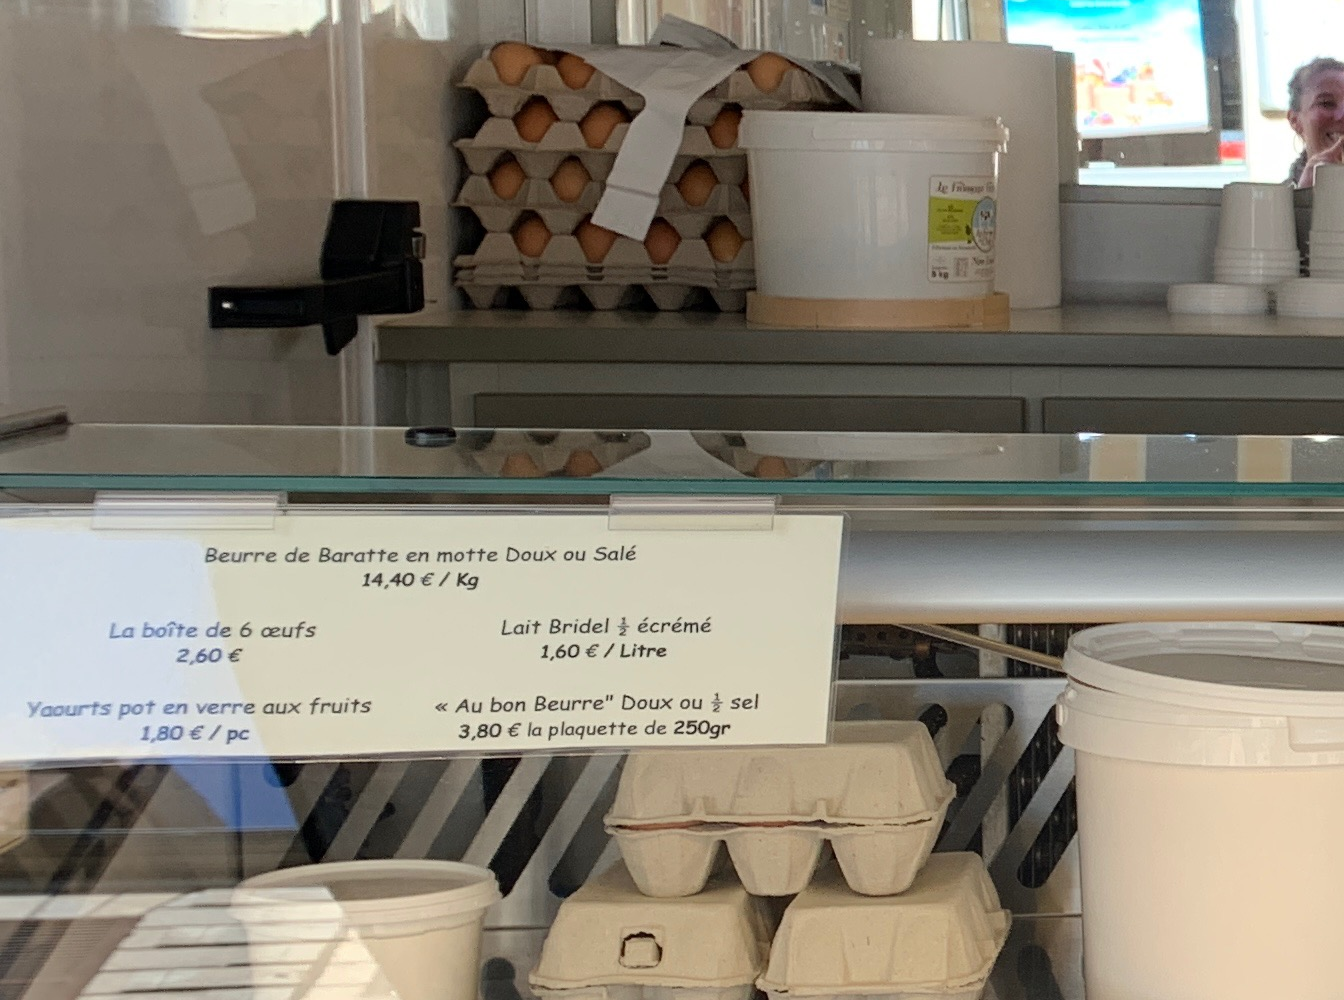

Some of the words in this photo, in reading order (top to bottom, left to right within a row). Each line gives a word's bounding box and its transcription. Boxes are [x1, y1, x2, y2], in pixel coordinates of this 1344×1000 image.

[205, 548, 276, 563] Beurre
[285, 547, 309, 563] de
[319, 547, 398, 563] Baratte
[406, 551, 431, 563] en
[437, 547, 498, 563] motte
[506, 547, 556, 563] Doux
[563, 549, 586, 561] ou
[594, 545, 637, 562] Salé
[363, 573, 414, 589] 14,40
[417, 573, 432, 587] €
[439, 572, 450, 587] /
[457, 573, 479, 590] Kg
[109, 623, 133, 638] La
[142, 620, 197, 638] boîte
[205, 622, 231, 638] de
[240, 623, 252, 637] 6
[261, 622, 316, 639] œufs
[501, 620, 541, 636] Lait
[549, 618, 609, 635] Bridel
[638, 617, 711, 634] écrémé
[176, 648, 222, 665] 2,60
[228, 648, 242, 663] €
[541, 644, 580, 661] 1,60
[586, 644, 600, 659] €
[604, 644, 615, 658] /
[620, 643, 666, 658] Litre
[118, 701, 155, 720] pot
[163, 704, 188, 716] en
[198, 702, 254, 716] verre
[263, 702, 301, 715] aux
[309, 698, 371, 716] fruits
[456, 698, 482, 714] Au
[490, 698, 526, 713] bon
[621, 695, 673, 710] Doux
[680, 697, 703, 710] ou
[730, 694, 759, 710] sel
[140, 725, 184, 742] 1,80
[190, 726, 203, 741] €
[209, 725, 220, 741] /
[227, 728, 249, 743] pc
[459, 724, 501, 740] 3,80
[508, 724, 521, 737] €
[528, 722, 542, 737] la
[549, 721, 637, 740] plaquette
[644, 721, 666, 735] de
[674, 721, 730, 738] 250gr
